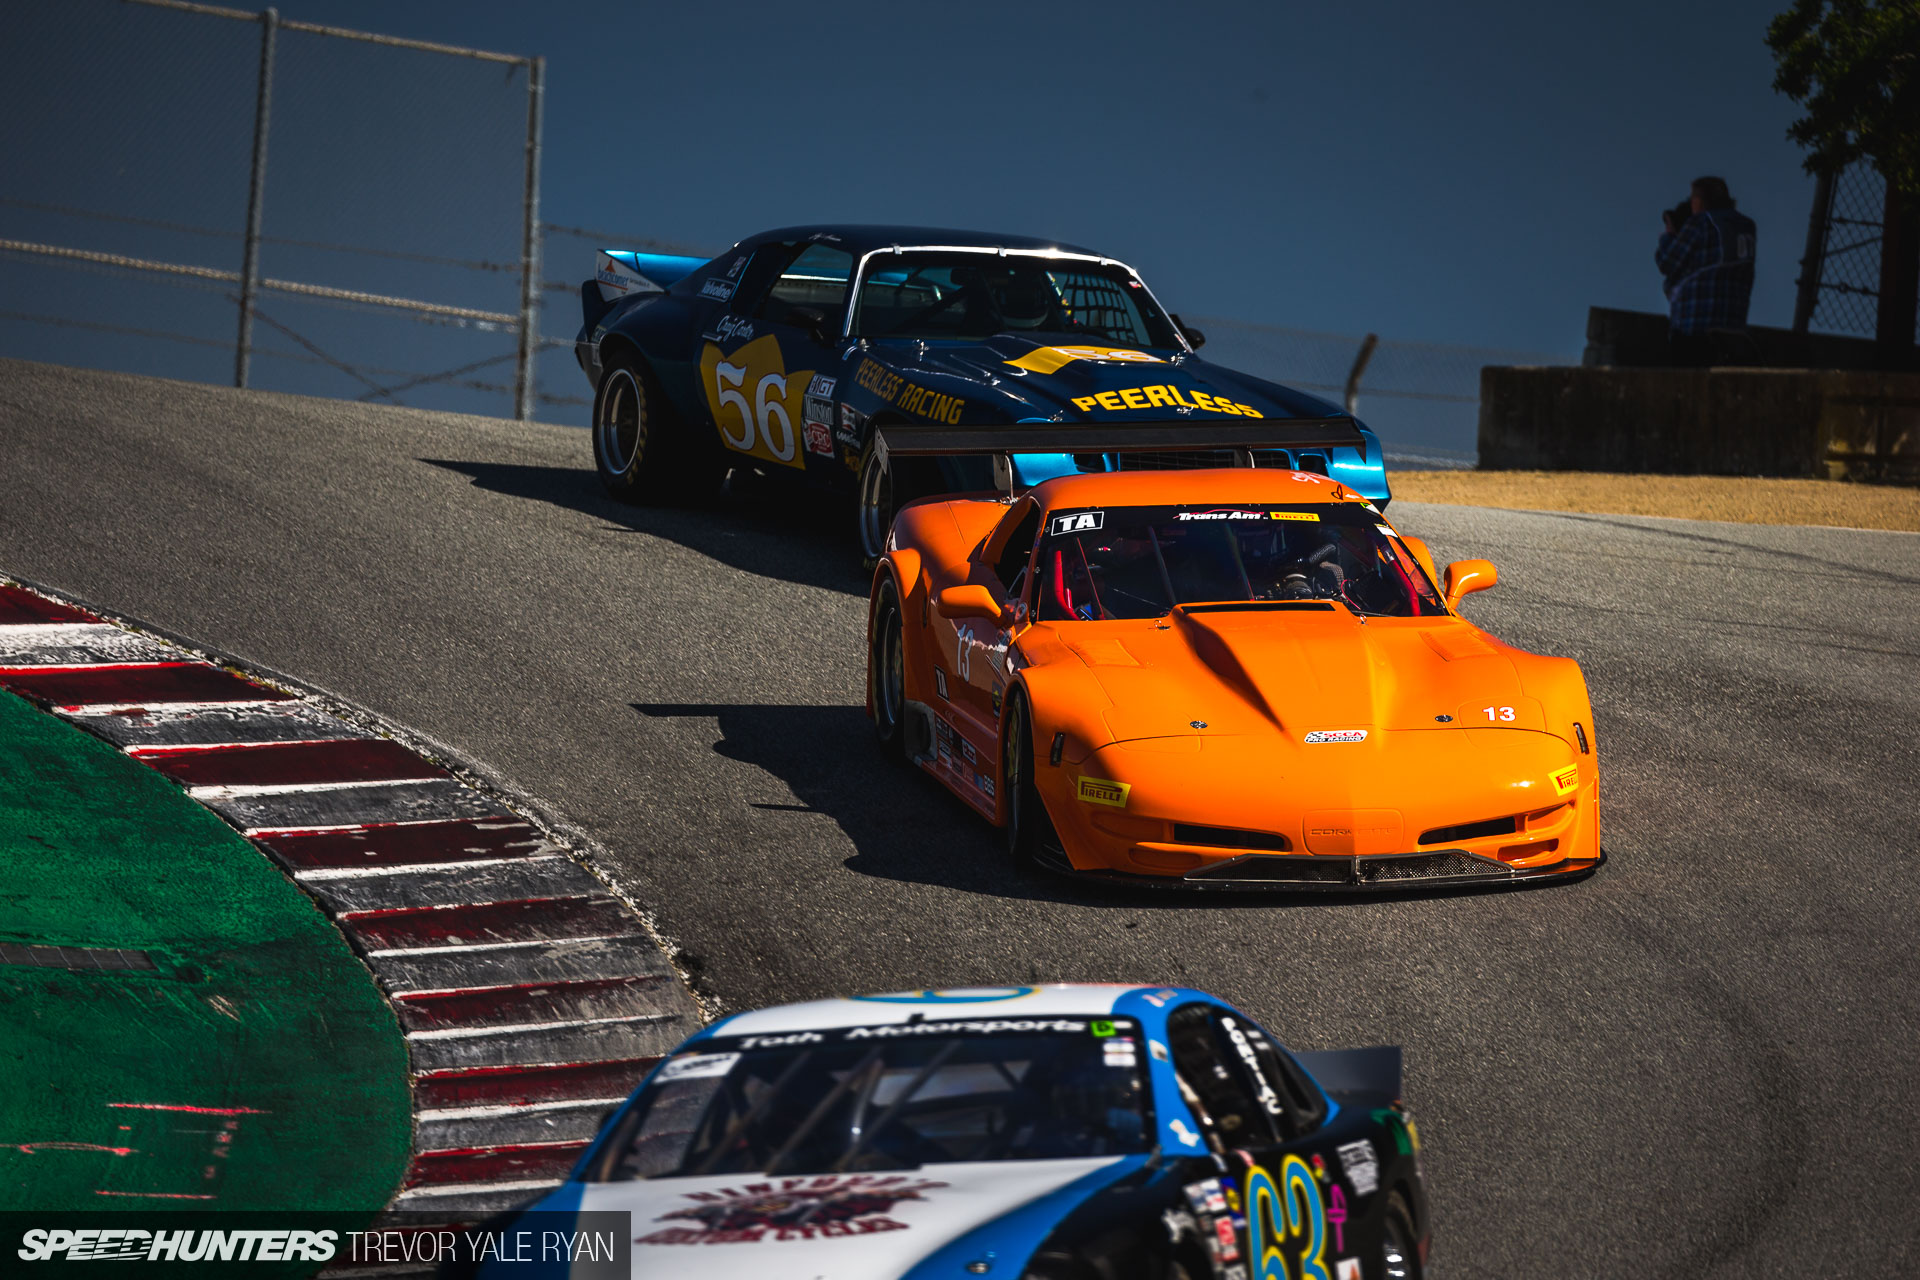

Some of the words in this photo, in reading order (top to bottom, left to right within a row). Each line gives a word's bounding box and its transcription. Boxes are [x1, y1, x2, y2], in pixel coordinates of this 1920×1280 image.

[854, 357, 904, 402] PEERLESS
[897, 383, 965, 425] RACING
[1071, 384, 1265, 419] PEERLESS
[715, 360, 796, 463] 56
[805, 395, 834, 425] Winston
[1059, 513, 1096, 532] TA
[1178, 512, 1228, 521] Trans
[1230, 511, 1261, 521] Am
[957, 623, 974, 682] 13
[935, 668, 949, 700] TA
[1482, 706, 1517, 722] 13
[1080, 780, 1123, 802] PIRELLI
[1555, 768, 1577, 789] PIREL
[738, 1031, 824, 1049] Toth
[845, 1018, 1087, 1041] Motorsports
[1246, 1154, 1331, 1280] 63
